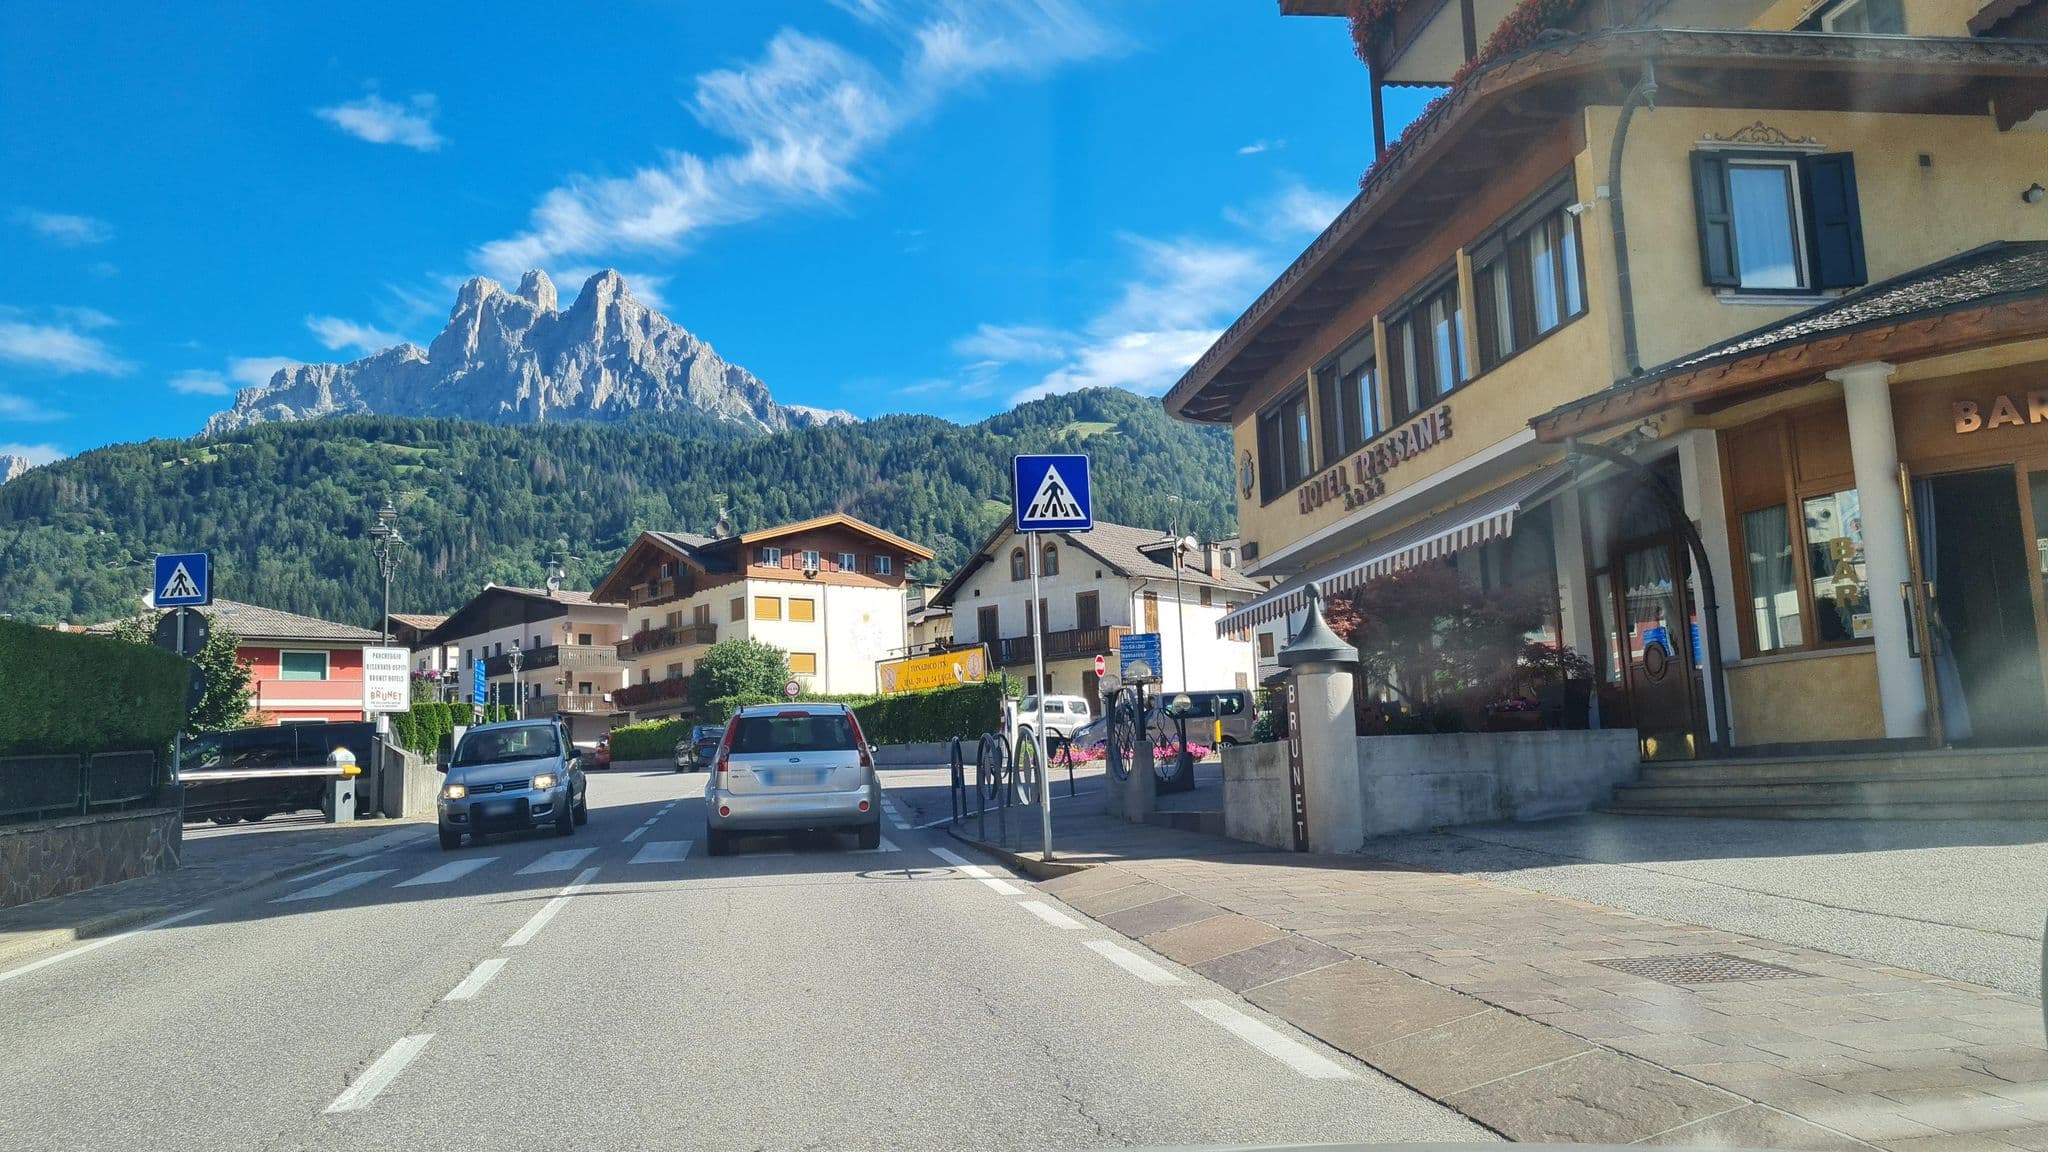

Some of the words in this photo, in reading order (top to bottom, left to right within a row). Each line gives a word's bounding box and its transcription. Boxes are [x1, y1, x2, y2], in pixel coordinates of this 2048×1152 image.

[1952, 392, 2048, 433] BAR
[1298, 465, 1347, 514] HOTEL
[1352, 405, 1453, 485] TRESSANE
[1830, 537, 1860, 608] BAR
[366, 663, 391, 671] RISERVATO
[372, 652, 402, 660] PARCHEGGIO
[369, 674, 388, 682] BRUNET
[388, 675, 405, 683] HOTELS
[370, 690, 402, 701] BRUNET
[1288, 684, 1303, 841] BRUNET
